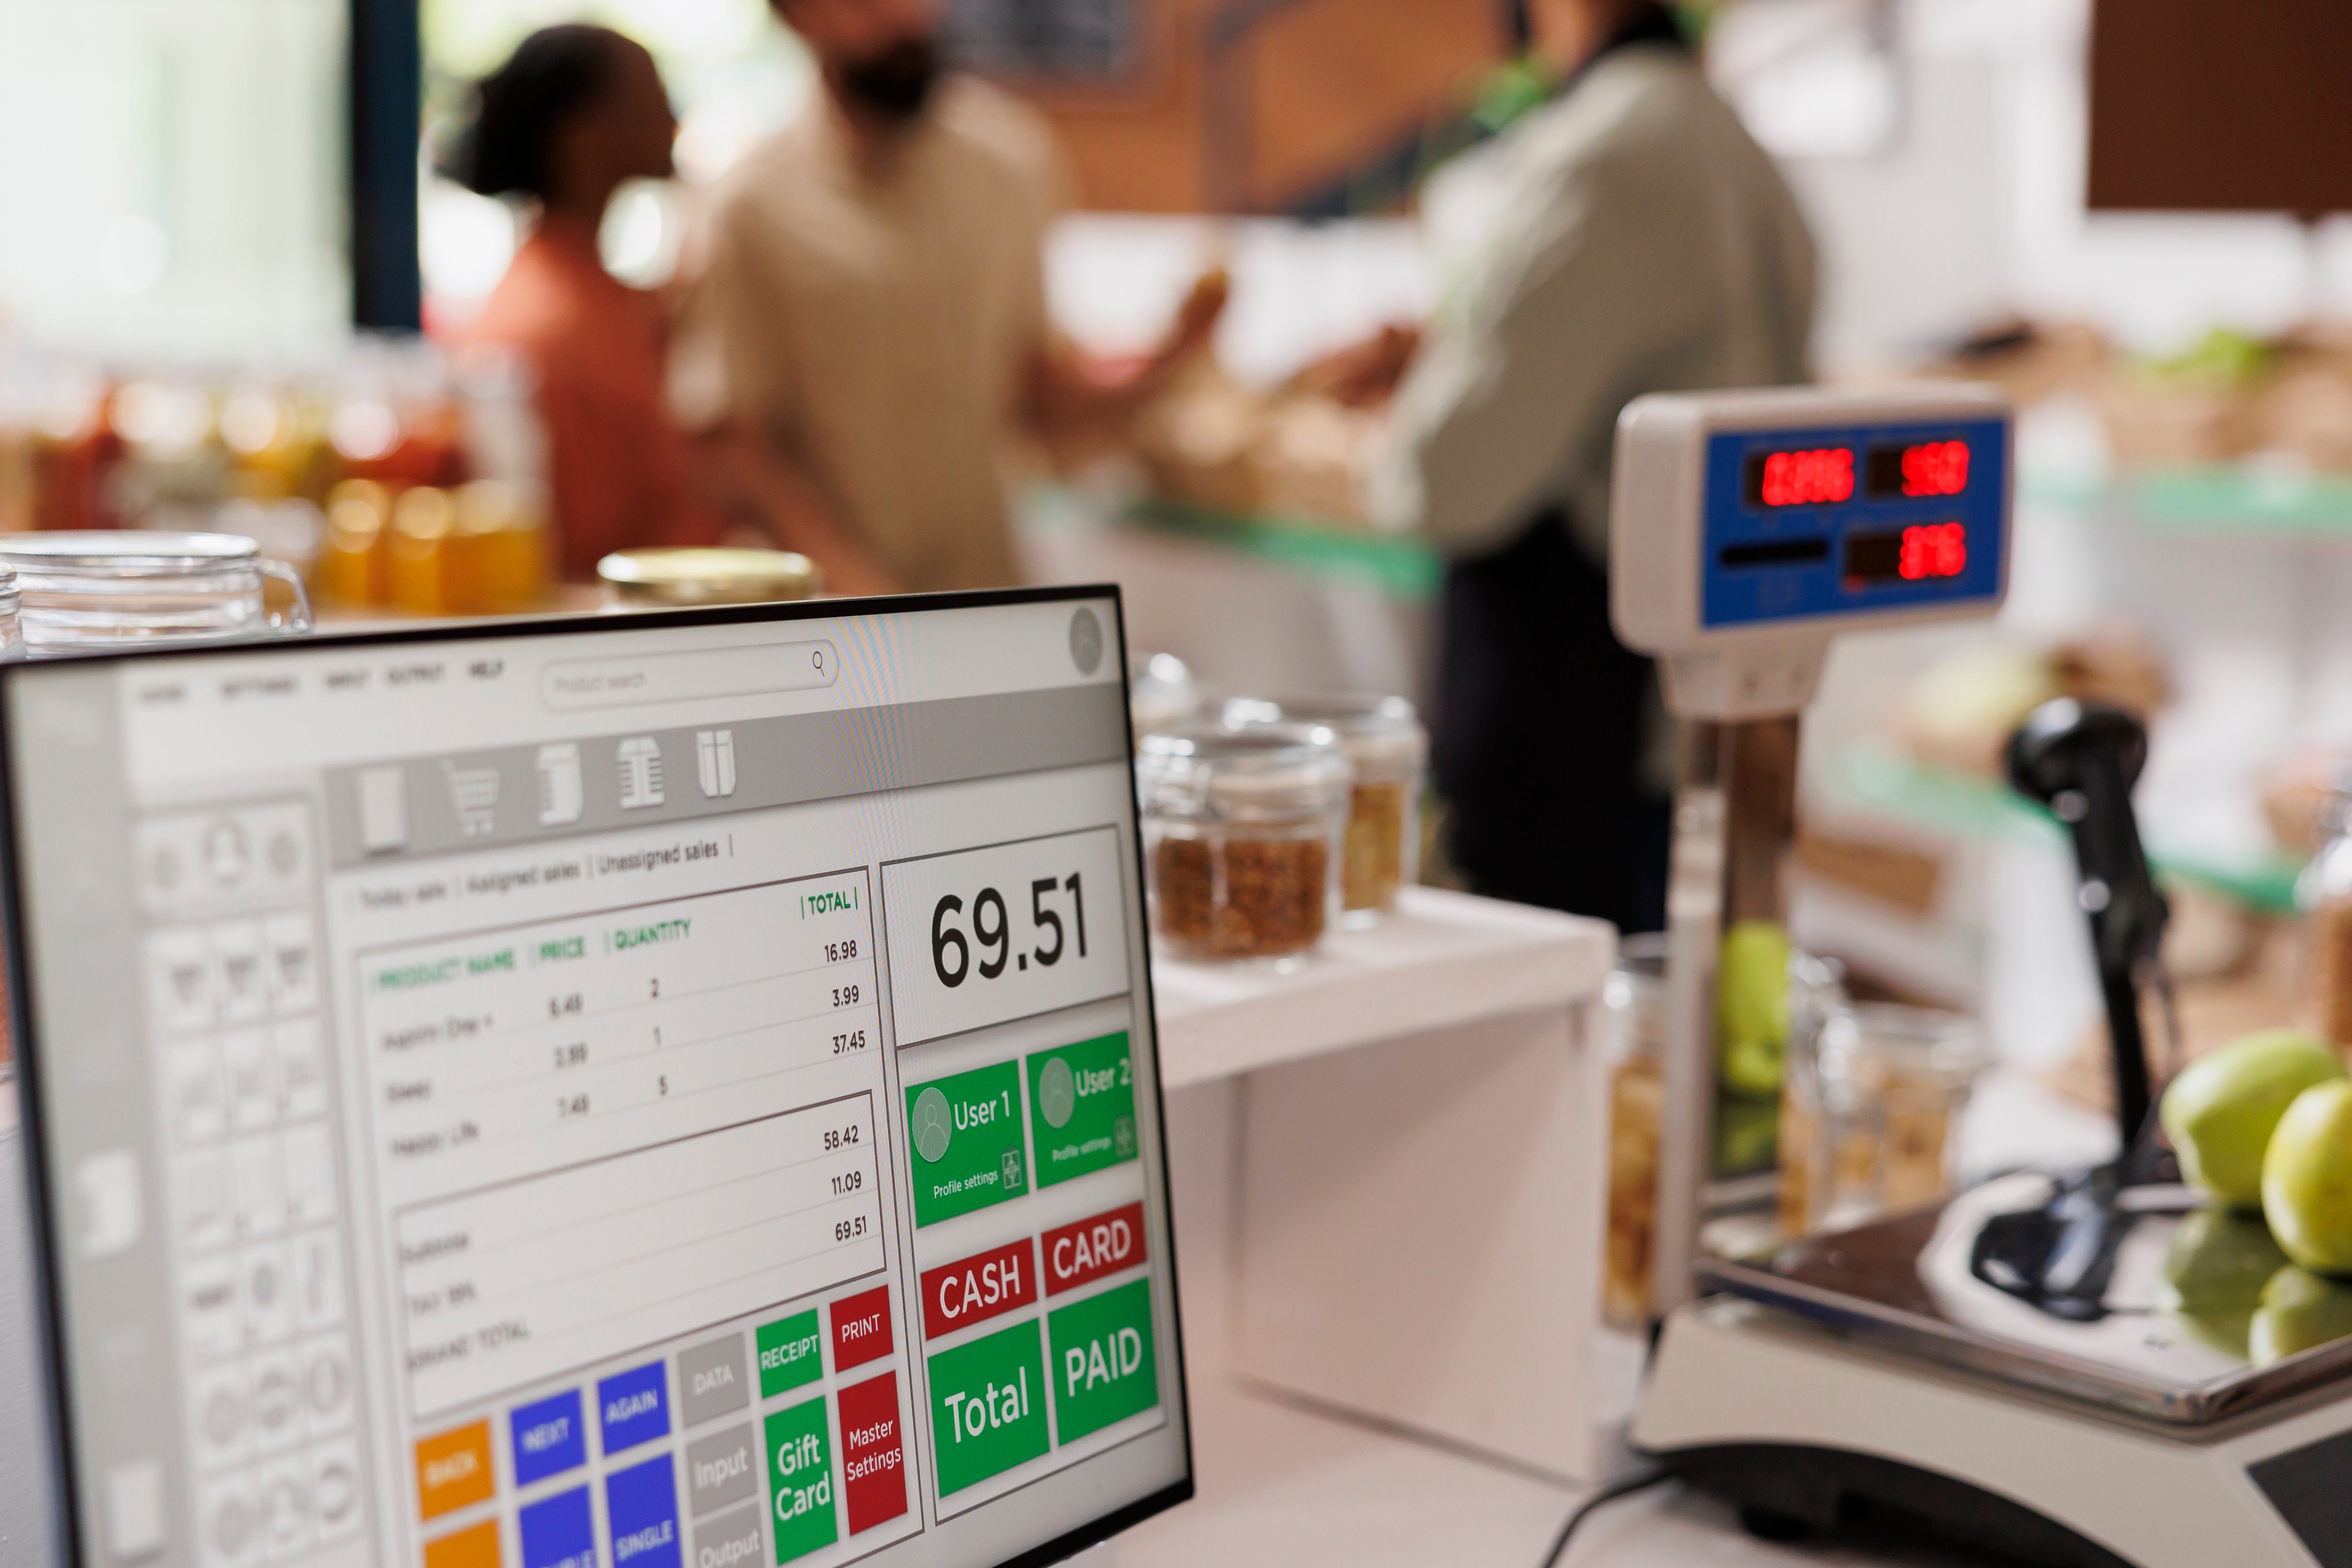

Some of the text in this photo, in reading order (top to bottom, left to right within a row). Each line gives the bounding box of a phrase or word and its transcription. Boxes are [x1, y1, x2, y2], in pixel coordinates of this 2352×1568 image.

[554, 672, 646, 693] Product search
[598, 844, 680, 874] Unassigned
[684, 840, 718, 861] sales
[468, 949, 514, 974] NAME
[540, 936, 584, 960] PRICE
[615, 918, 691, 950] QUANTITY
[932, 871, 1086, 988] 69.51
[824, 939, 857, 962] 16.98
[650, 978, 659, 998] 2
[832, 985, 859, 1007] 3.99
[654, 1027, 661, 1046] 1
[832, 1030, 865, 1054] 37.45
[659, 1075, 668, 1095] 5
[1075, 1058, 1132, 1097] User 2
[955, 1090, 1010, 1130] User 1
[824, 1125, 859, 1151] 58.42
[1052, 1137, 1112, 1162] Profile settings
[831, 1171, 862, 1195] 11.09
[933, 1169, 999, 1199] Profile settings
[835, 1215, 867, 1241] 69.51
[1053, 1219, 1131, 1280] CARD
[940, 1255, 1021, 1319] CASH
[841, 1314, 880, 1342] PRINT
[760, 1334, 818, 1370] RECEIPT
[1065, 1327, 1142, 1397] PAID
[693, 1364, 734, 1395] DATA
[605, 1389, 658, 1424] AGAIN
[944, 1366, 1029, 1444] Total
[523, 1417, 570, 1453] NEXT
[849, 1420, 893, 1449] Master
[695, 1446, 748, 1489] Input
[777, 1433, 821, 1476] Gift
[847, 1447, 901, 1481] Settings
[775, 1471, 830, 1521] Card
[617, 1520, 673, 1561] SINGLE
[698, 1530, 761, 1568] Output
